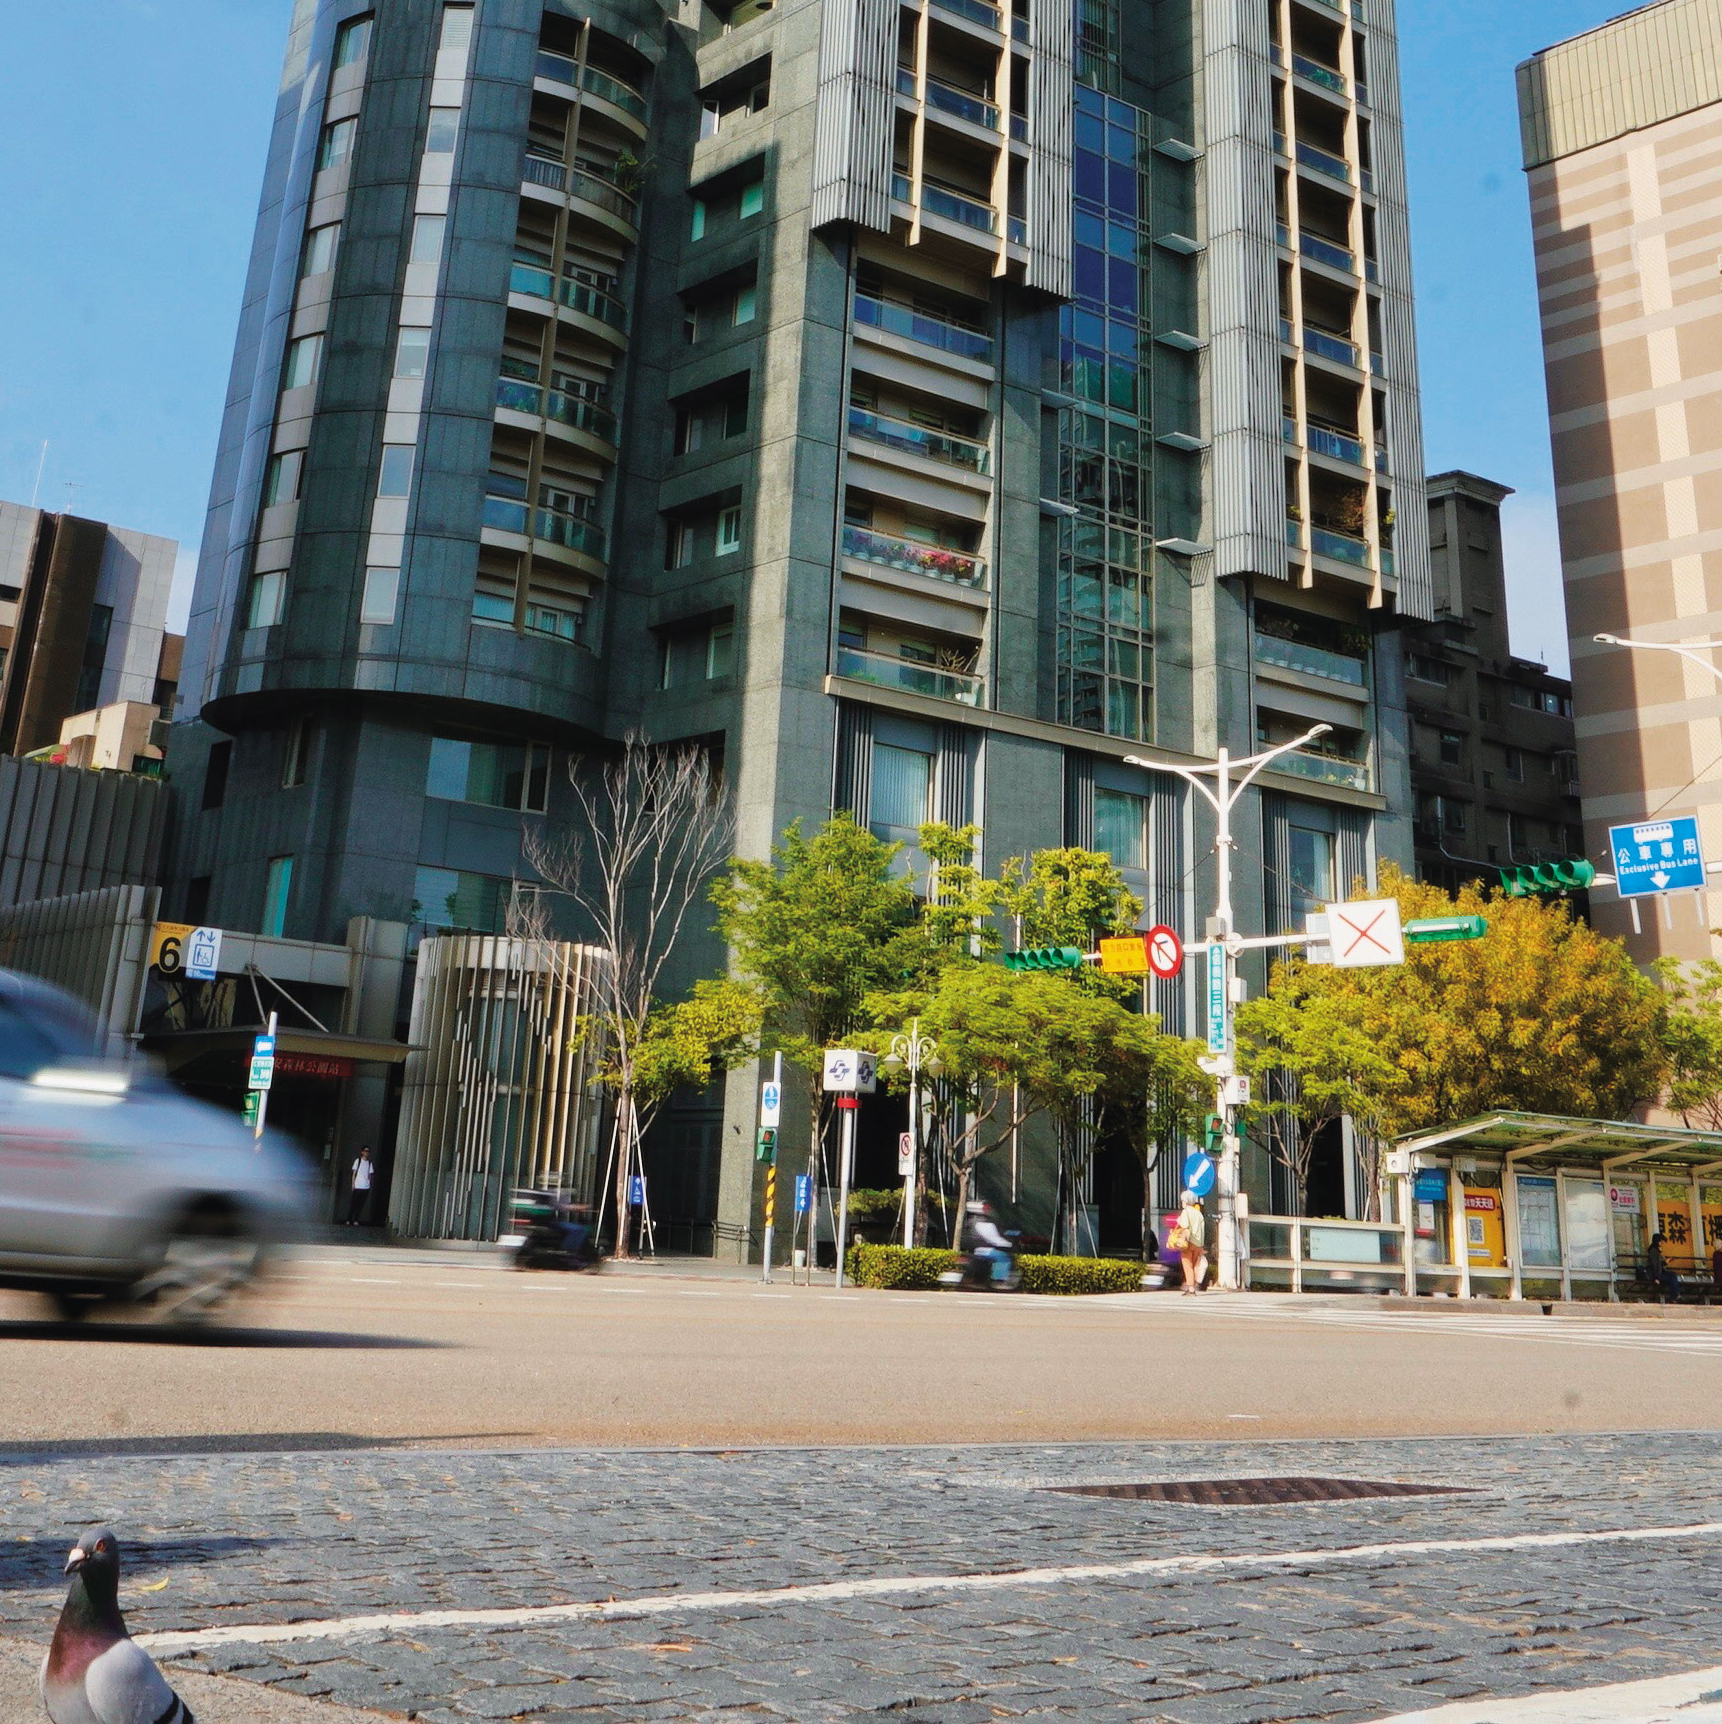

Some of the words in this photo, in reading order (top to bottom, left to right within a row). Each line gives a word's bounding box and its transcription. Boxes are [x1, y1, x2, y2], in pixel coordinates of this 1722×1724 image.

[1618, 838, 1697, 864] 公車專用
[1619, 862, 1659, 875] Exclusive
[1660, 859, 1676, 869] Bus
[1677, 857, 1698, 867] Lane
[159, 937, 181, 973] 6
[275, 1058, 339, 1075] 安森林公園站
